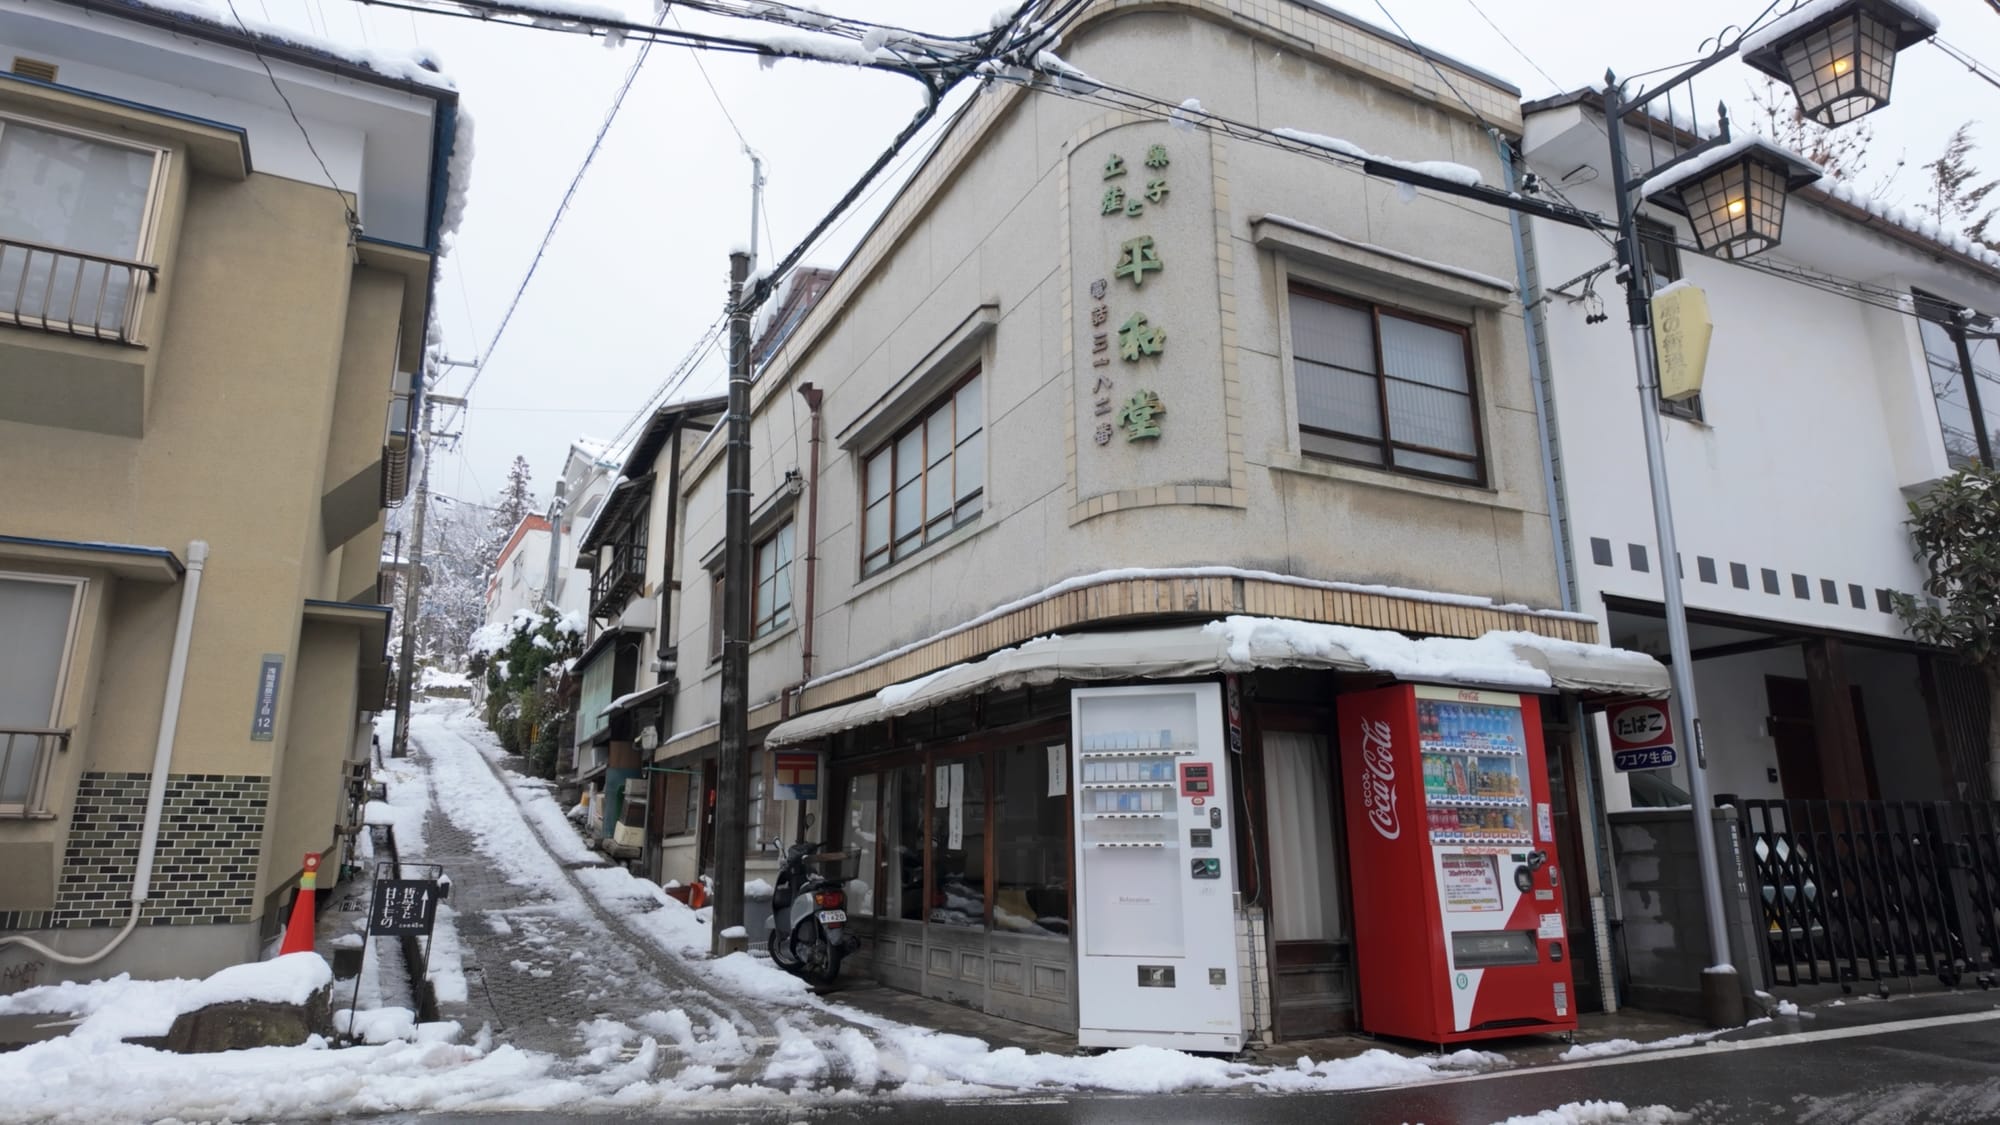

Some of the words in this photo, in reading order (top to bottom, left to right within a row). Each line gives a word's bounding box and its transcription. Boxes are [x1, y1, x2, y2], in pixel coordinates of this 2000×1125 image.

[1114, 234, 1167, 444] 平和堂
[257, 717, 271, 728] 12
[1617, 712, 1663, 736] たばこ
[1617, 749, 1673, 767] フコク生命
[1738, 882, 1747, 893] 11
[380, 887, 397, 928] 甘いもの
[401, 887, 417, 919] 哲学と
